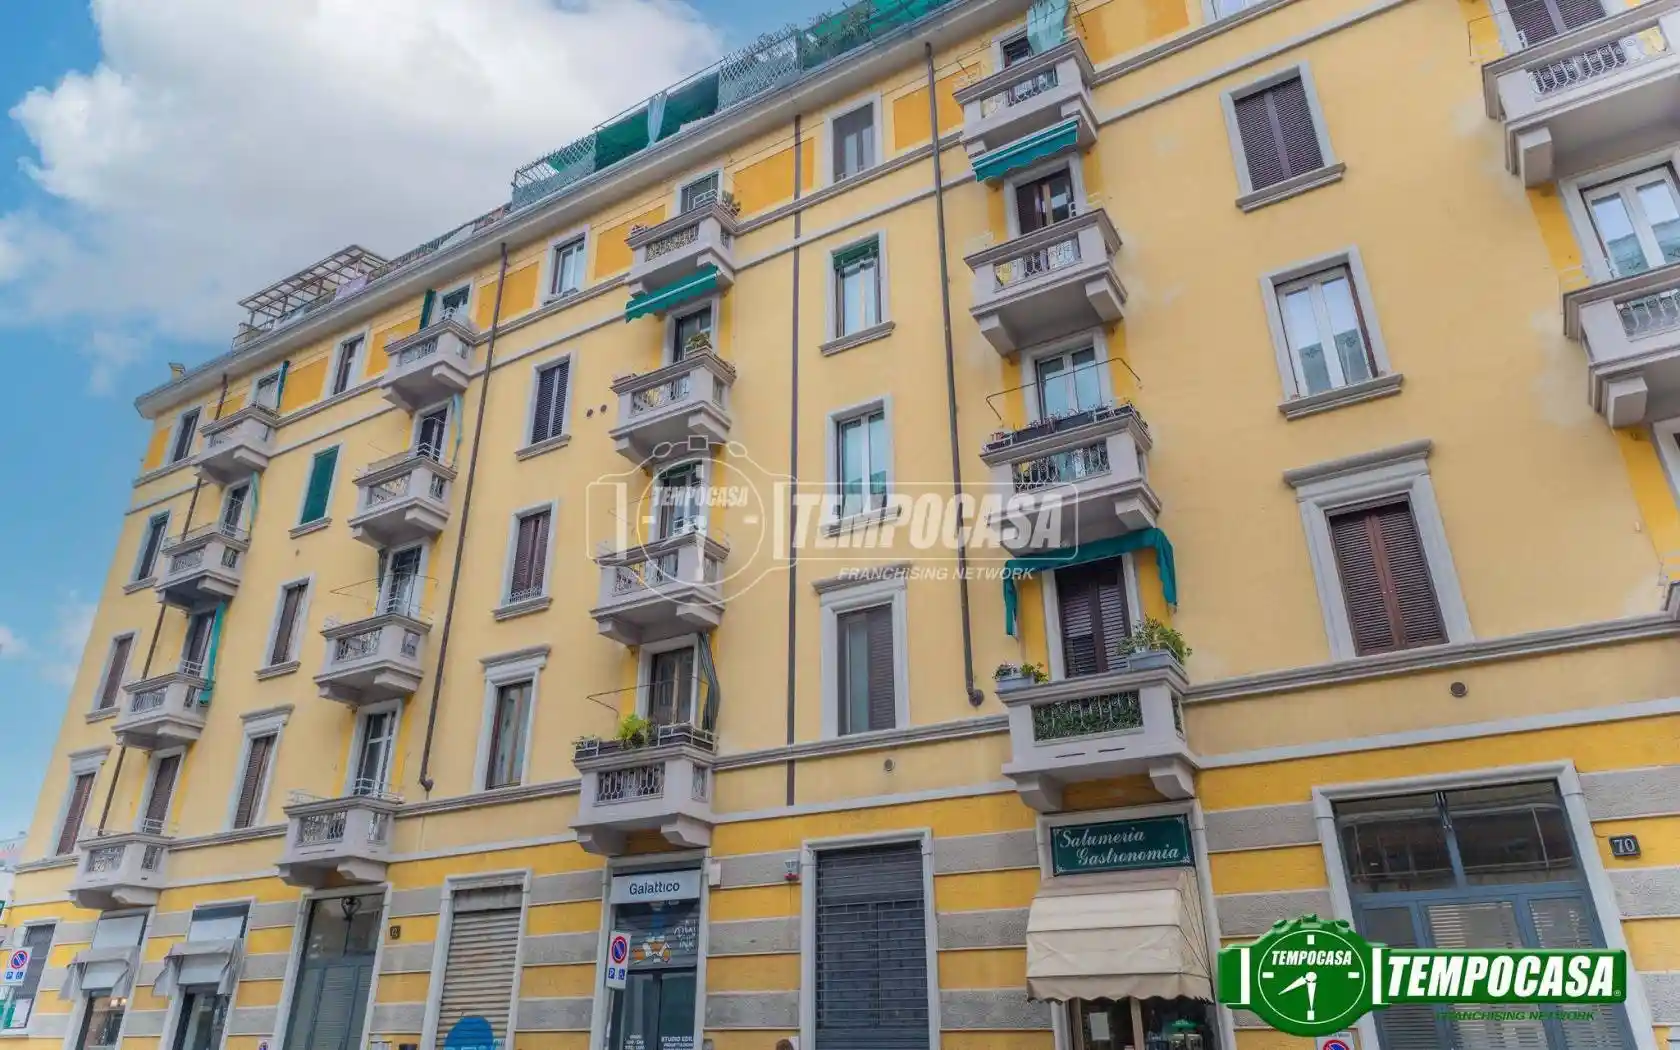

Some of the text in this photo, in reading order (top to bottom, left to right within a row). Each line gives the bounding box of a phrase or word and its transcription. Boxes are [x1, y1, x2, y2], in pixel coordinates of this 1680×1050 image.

[1060, 826, 1145, 848] Salumeria
[1612, 838, 1635, 853] 70
[1076, 844, 1179, 866] Gastronomia
